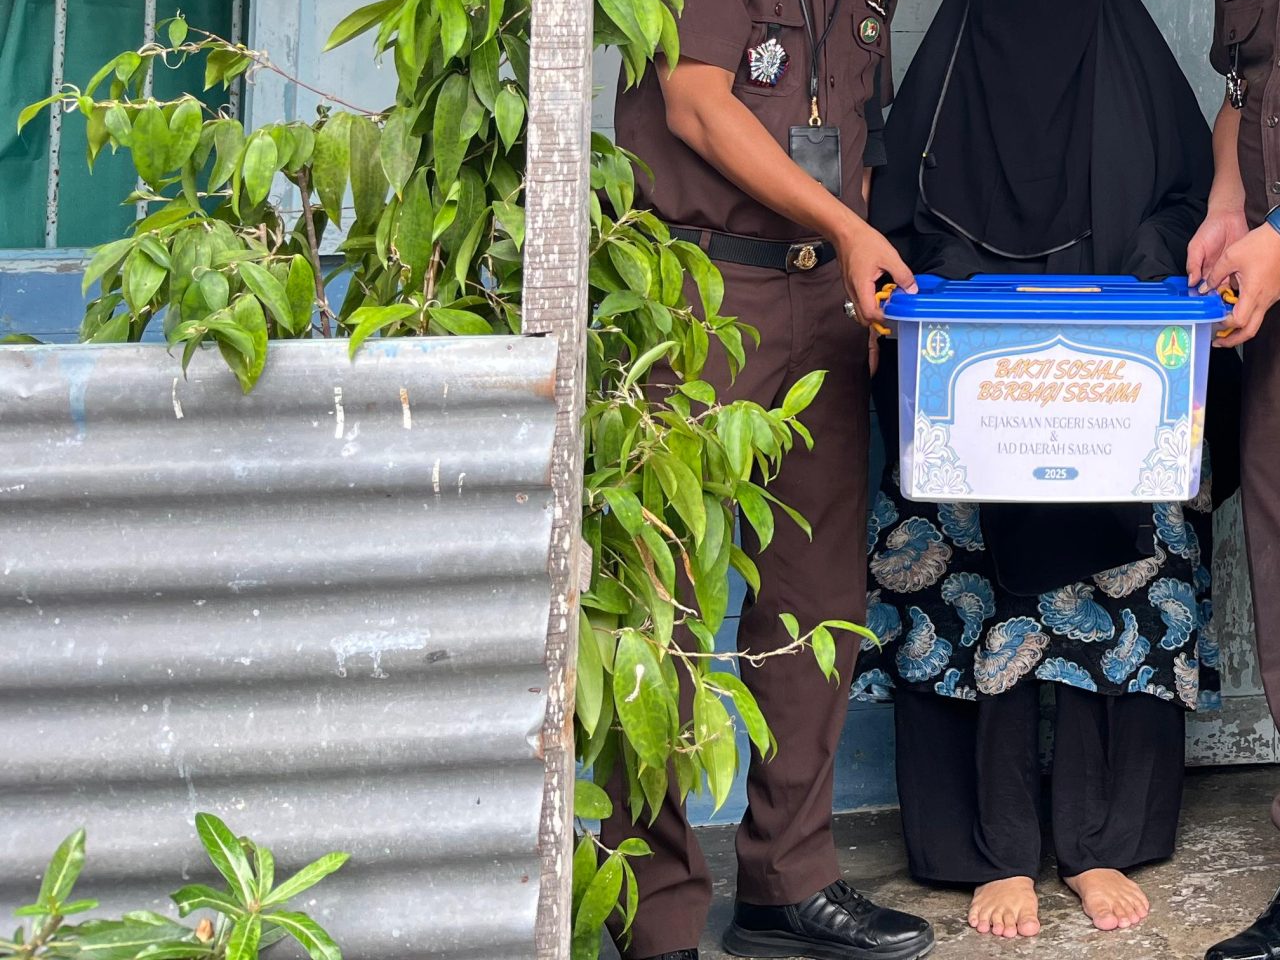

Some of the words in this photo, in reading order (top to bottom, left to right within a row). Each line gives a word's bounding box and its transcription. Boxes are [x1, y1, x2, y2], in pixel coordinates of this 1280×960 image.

[995, 358, 1055, 380] BAKTI
[1053, 359, 1127, 381] SOSIAL
[976, 380, 1064, 408] BERBAGI
[1062, 382, 1142, 404] SESAMA
[980, 415, 1042, 431] KEJAKSAAN
[1044, 416, 1085, 429] NEGERI
[1087, 417, 1131, 429] SABANG
[1049, 431, 1059, 442] &
[997, 442, 1017, 455] IAD
[1019, 442, 1065, 455] DAERAH
[1067, 443, 1112, 456] SABANG
[1044, 468, 1067, 479] 2025
